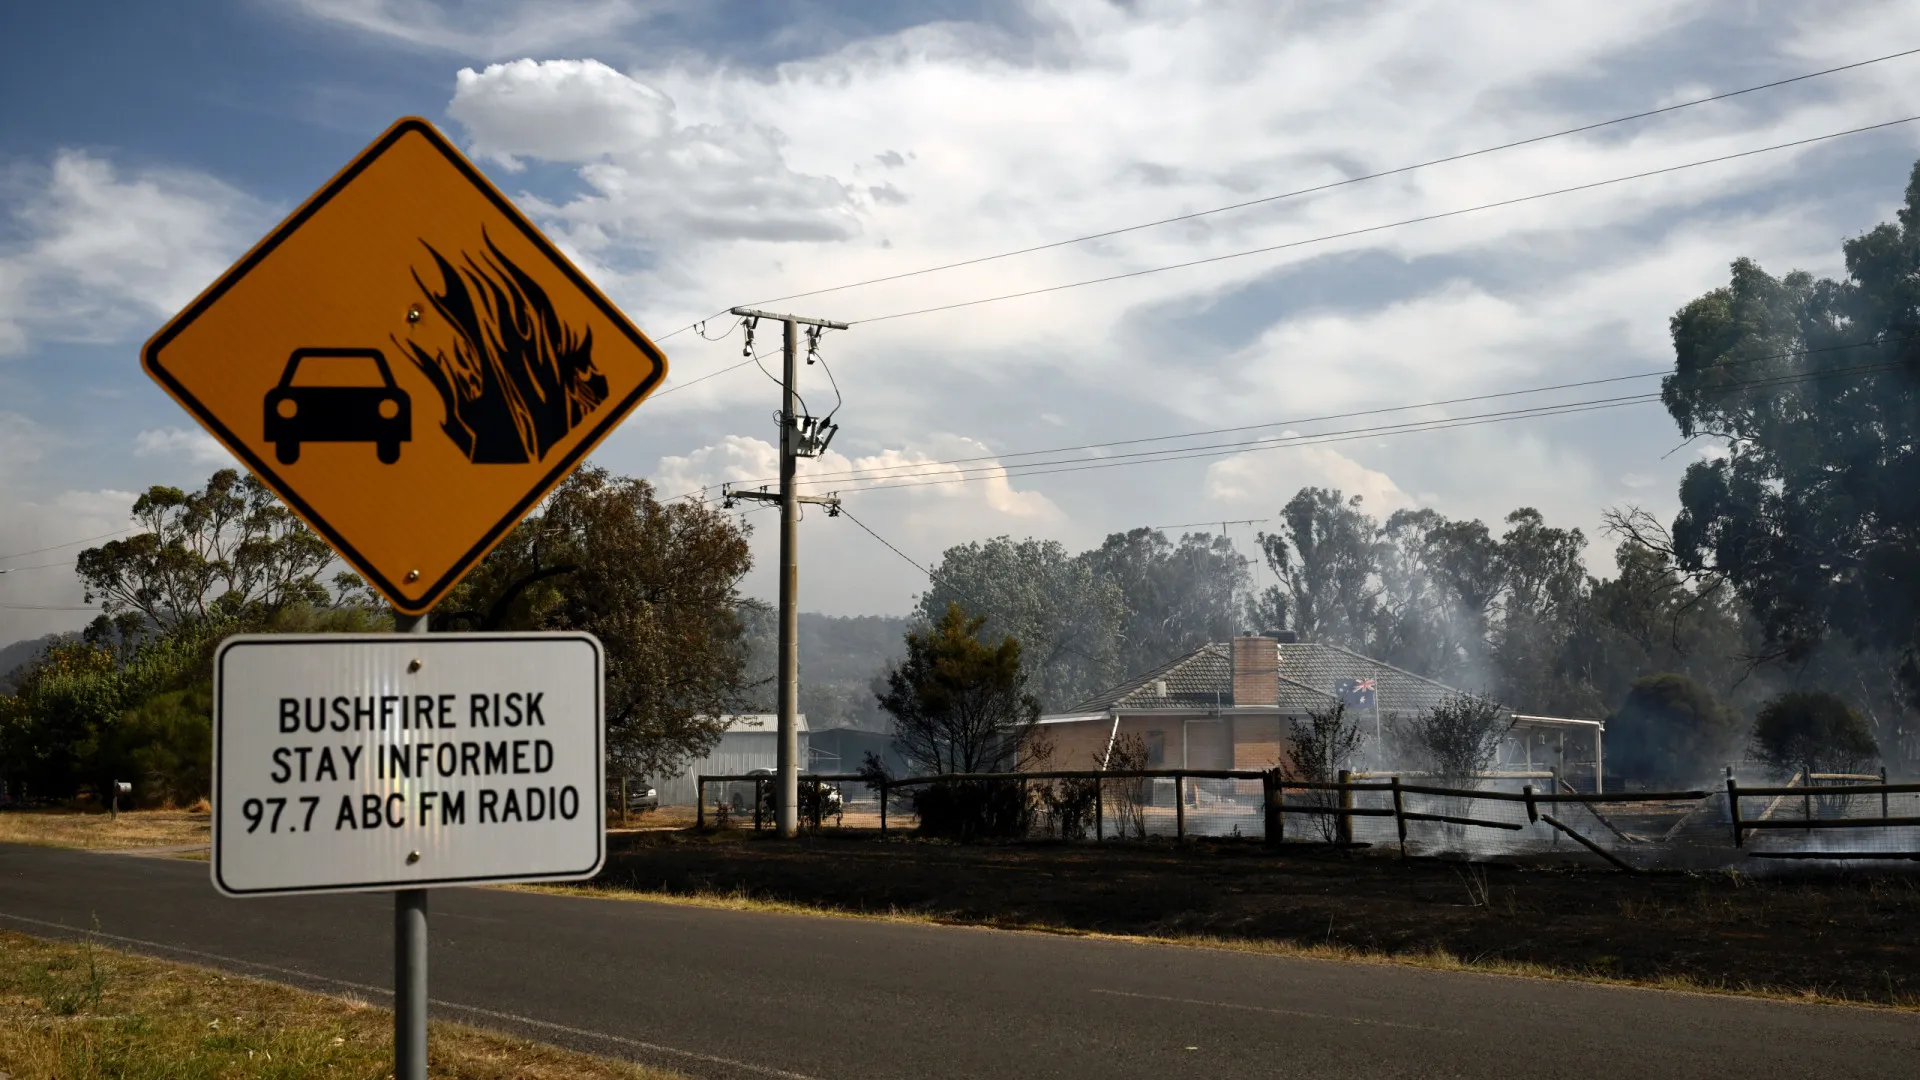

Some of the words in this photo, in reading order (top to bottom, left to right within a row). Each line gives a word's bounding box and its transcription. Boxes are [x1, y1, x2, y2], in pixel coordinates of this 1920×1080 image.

[279, 694, 456, 734] BUSHFIRE
[470, 692, 545, 728] RISK
[271, 745, 363, 784] STAY
[378, 739, 554, 780] INFORMED
[242, 796, 320, 834] 97.7
[335, 793, 405, 831] ABC
[419, 790, 465, 827] FM
[479, 785, 580, 824] RADIO
